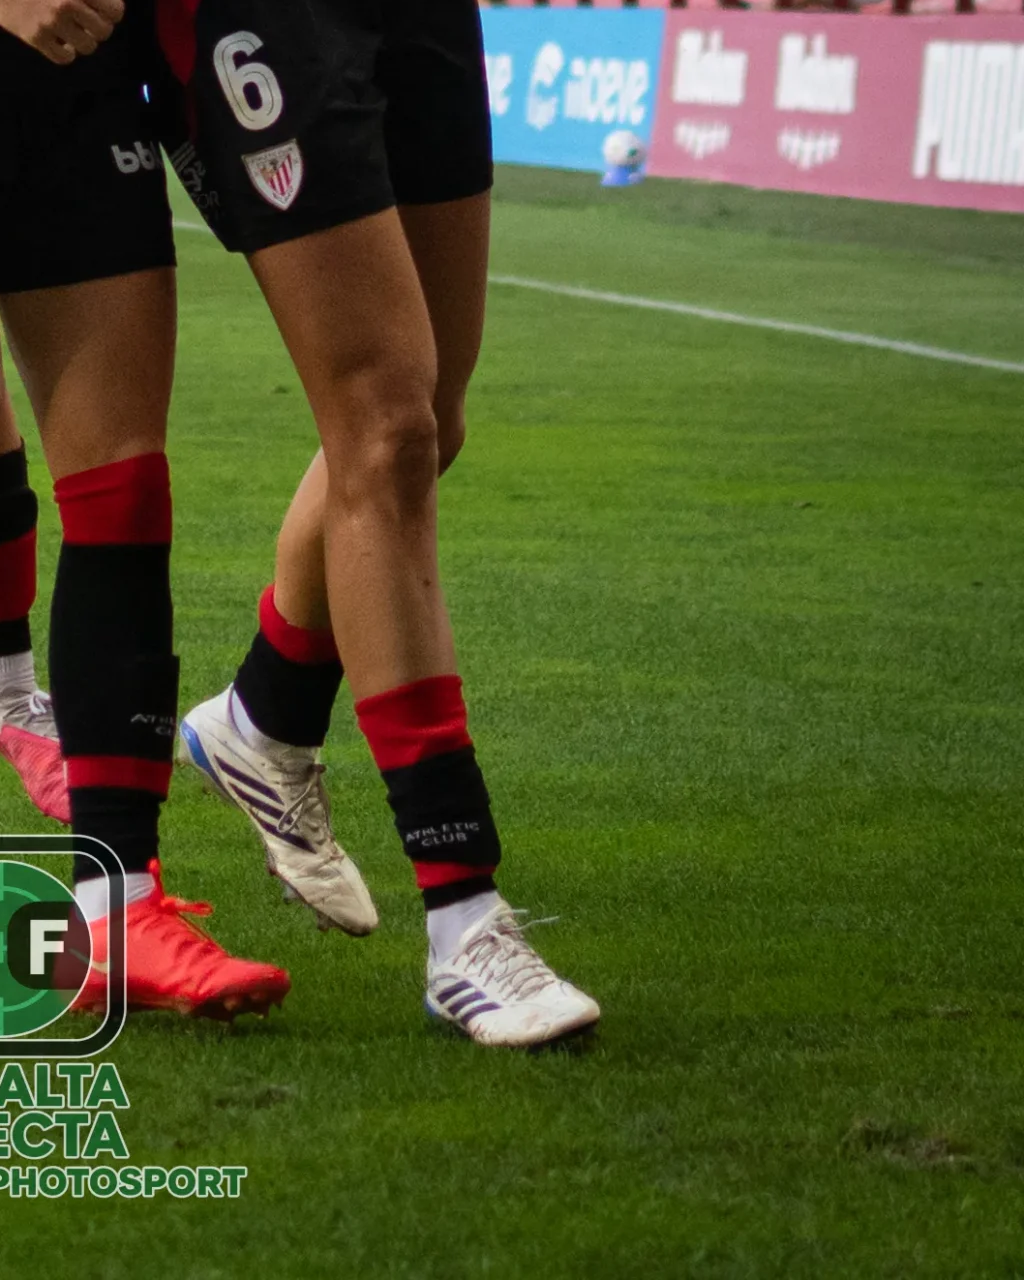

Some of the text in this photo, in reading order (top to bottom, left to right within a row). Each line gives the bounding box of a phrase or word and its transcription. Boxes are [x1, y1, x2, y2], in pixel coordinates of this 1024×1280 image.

[213, 30, 283, 131] 6
[405, 822, 480, 843] ATHLETIC
[421, 832, 468, 847] CLUB
